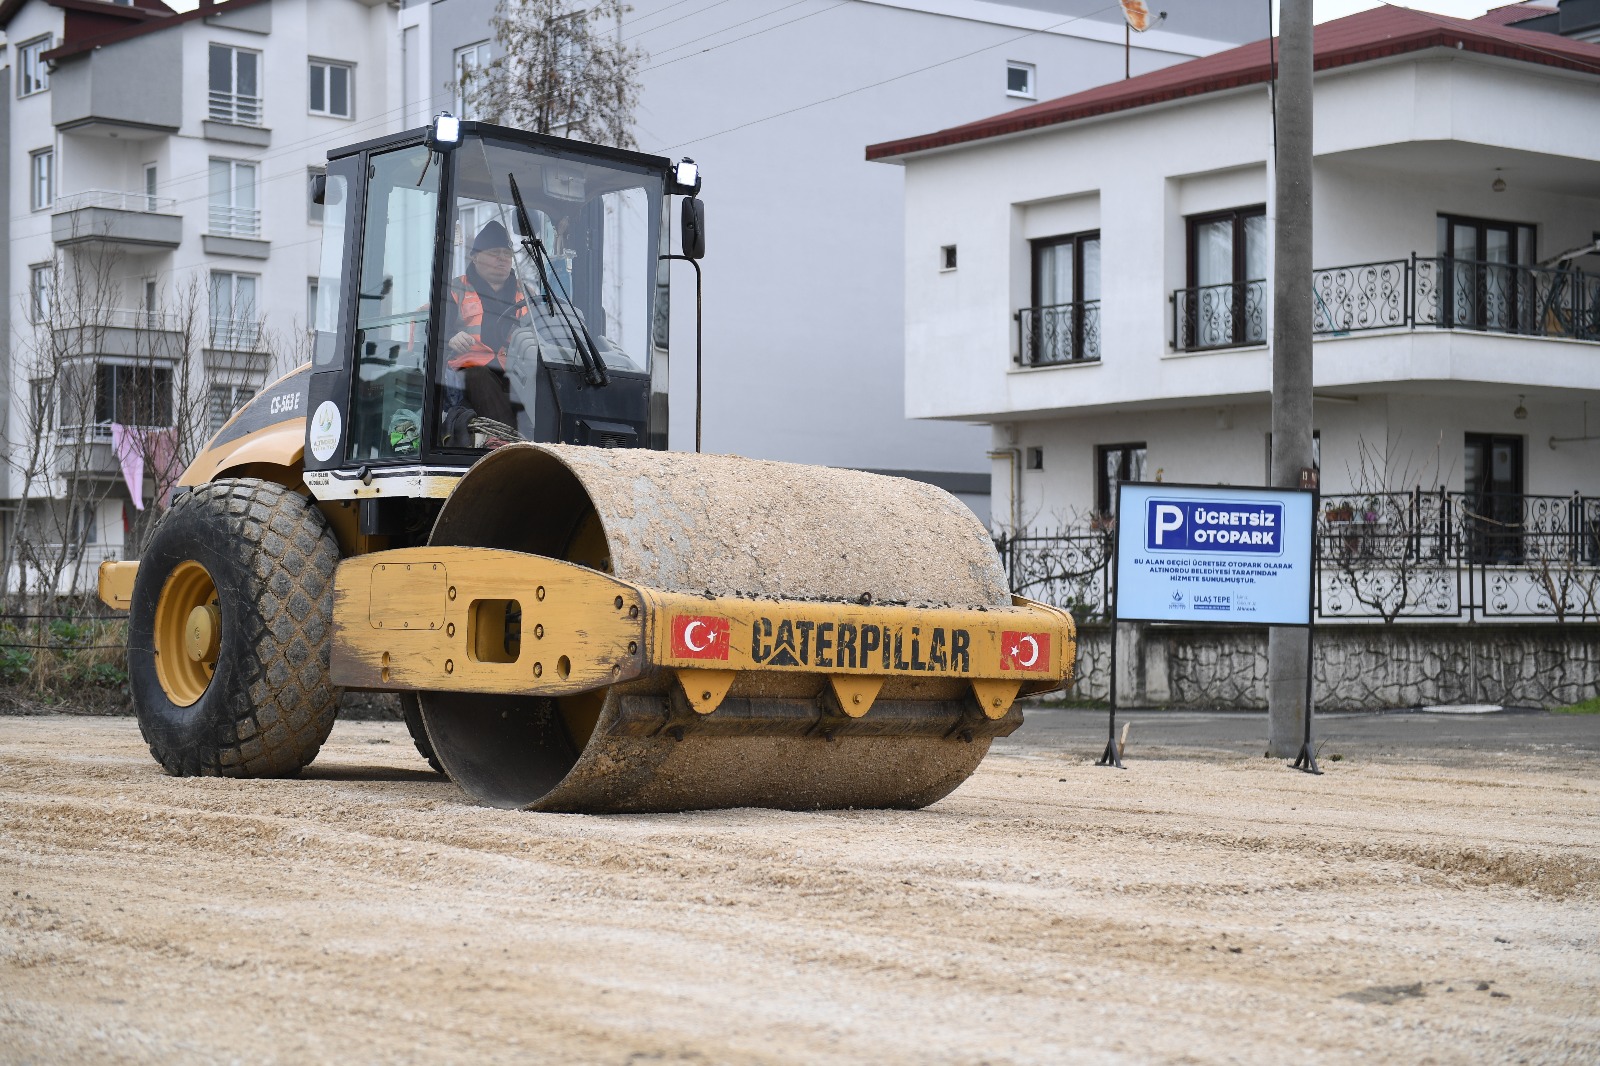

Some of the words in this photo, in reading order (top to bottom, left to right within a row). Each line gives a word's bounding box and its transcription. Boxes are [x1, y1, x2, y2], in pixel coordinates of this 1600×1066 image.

[1194, 507, 1275, 527] ÜCRETSİZ
[1155, 505, 1184, 545] P
[1194, 530, 1274, 545] OTOPARK
[1166, 558, 1191, 567] GEÇİCİ
[1192, 558, 1226, 567] ÜCRETSİZ
[1191, 567, 1231, 575] BELEDİYESİ
[1170, 574, 1200, 582] HİZMETE
[1201, 576, 1256, 584] SUNULMUŞTUR.
[1193, 595, 1211, 604] ULAŞ
[751, 616, 970, 673] CATERPILLAR
